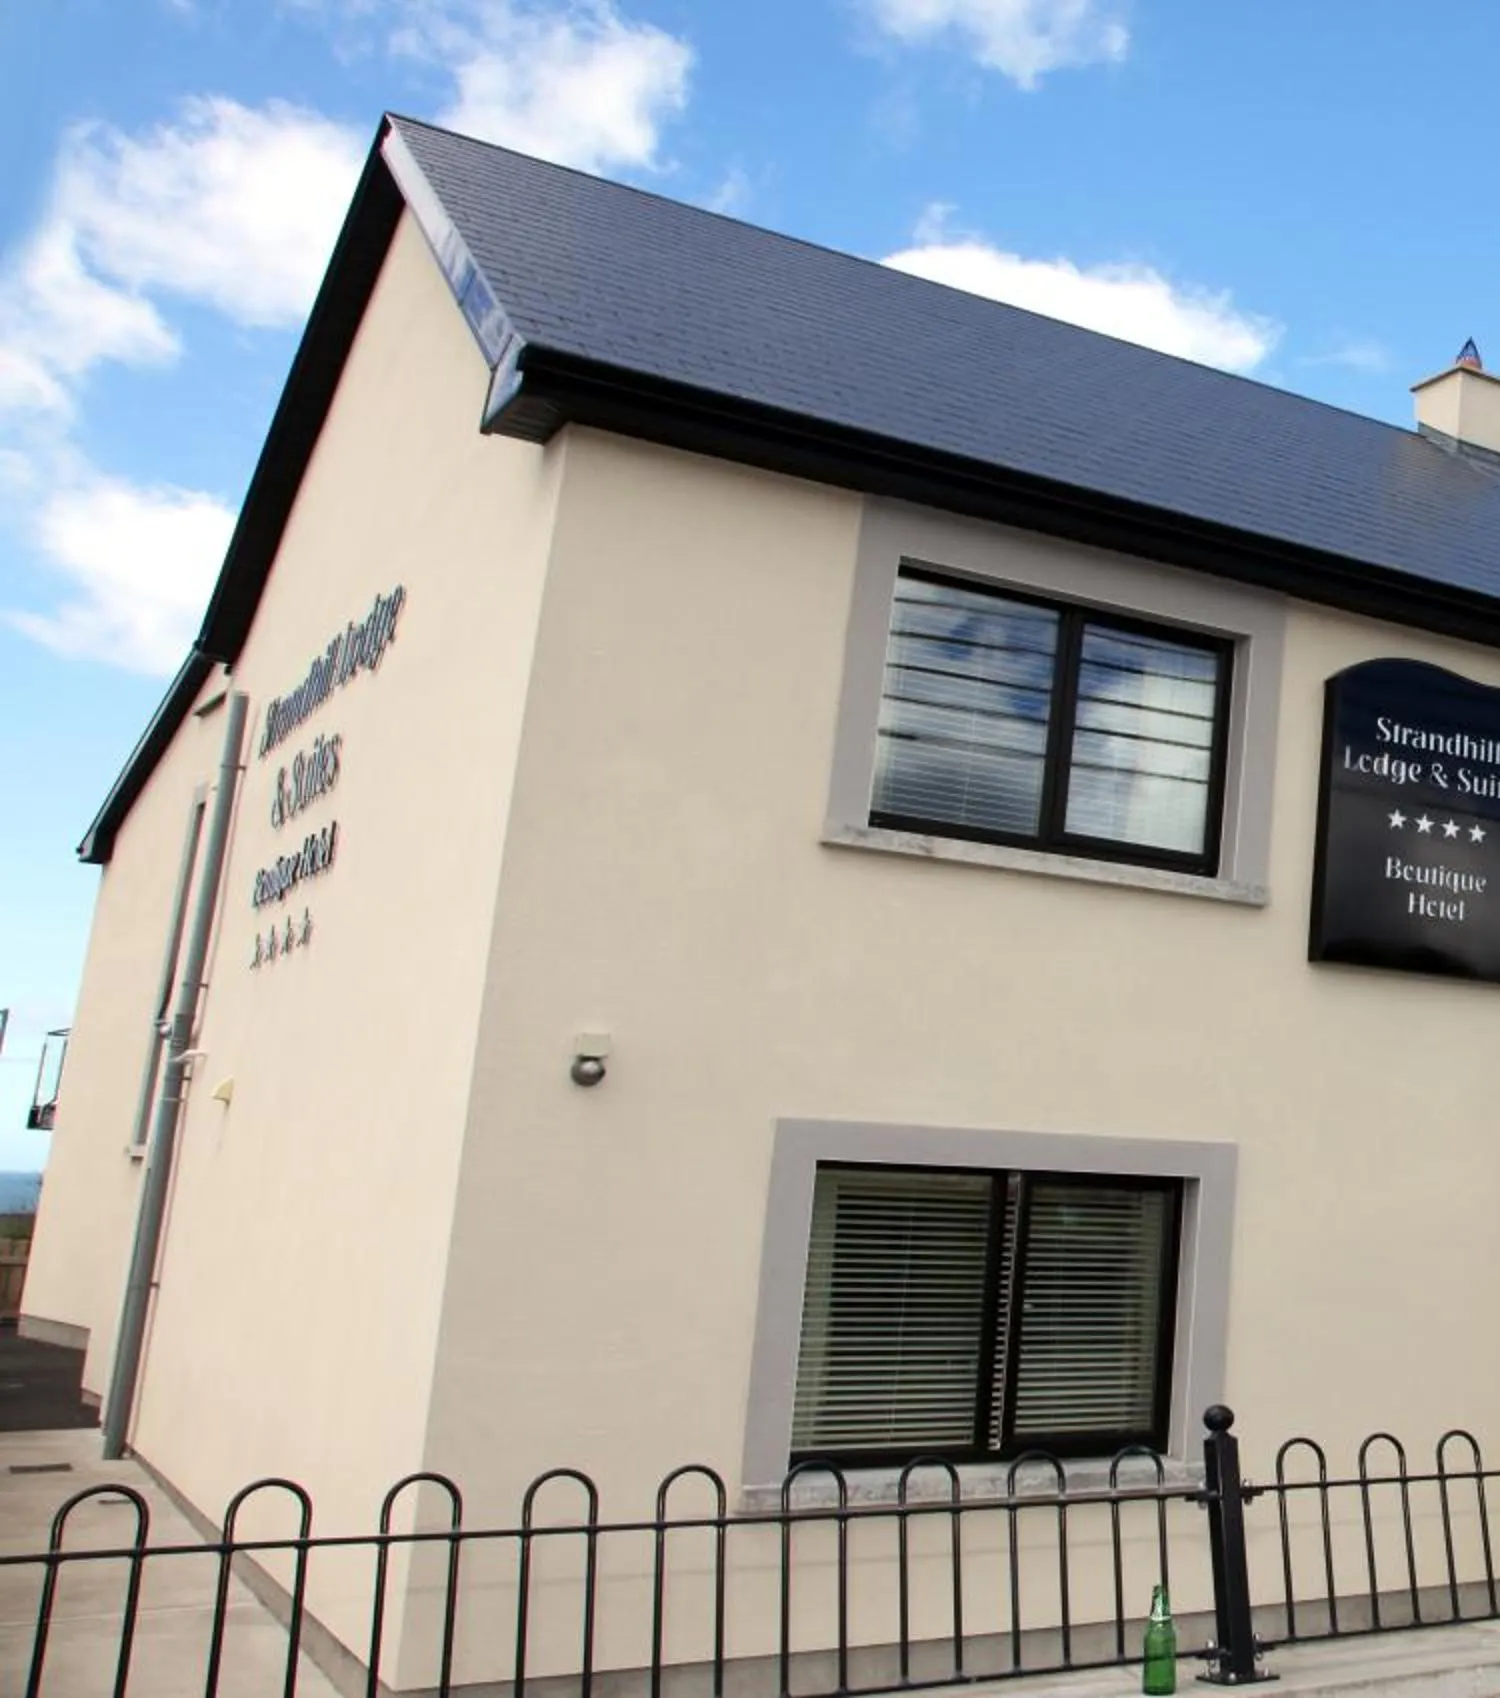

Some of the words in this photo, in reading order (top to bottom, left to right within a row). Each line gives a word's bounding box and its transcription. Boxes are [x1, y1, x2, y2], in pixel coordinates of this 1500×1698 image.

[1344, 744, 1422, 784] Lodge
[1431, 763, 1449, 789] &
[1385, 856, 1487, 894] Boutique
[1408, 892, 1466, 921] Hotel
